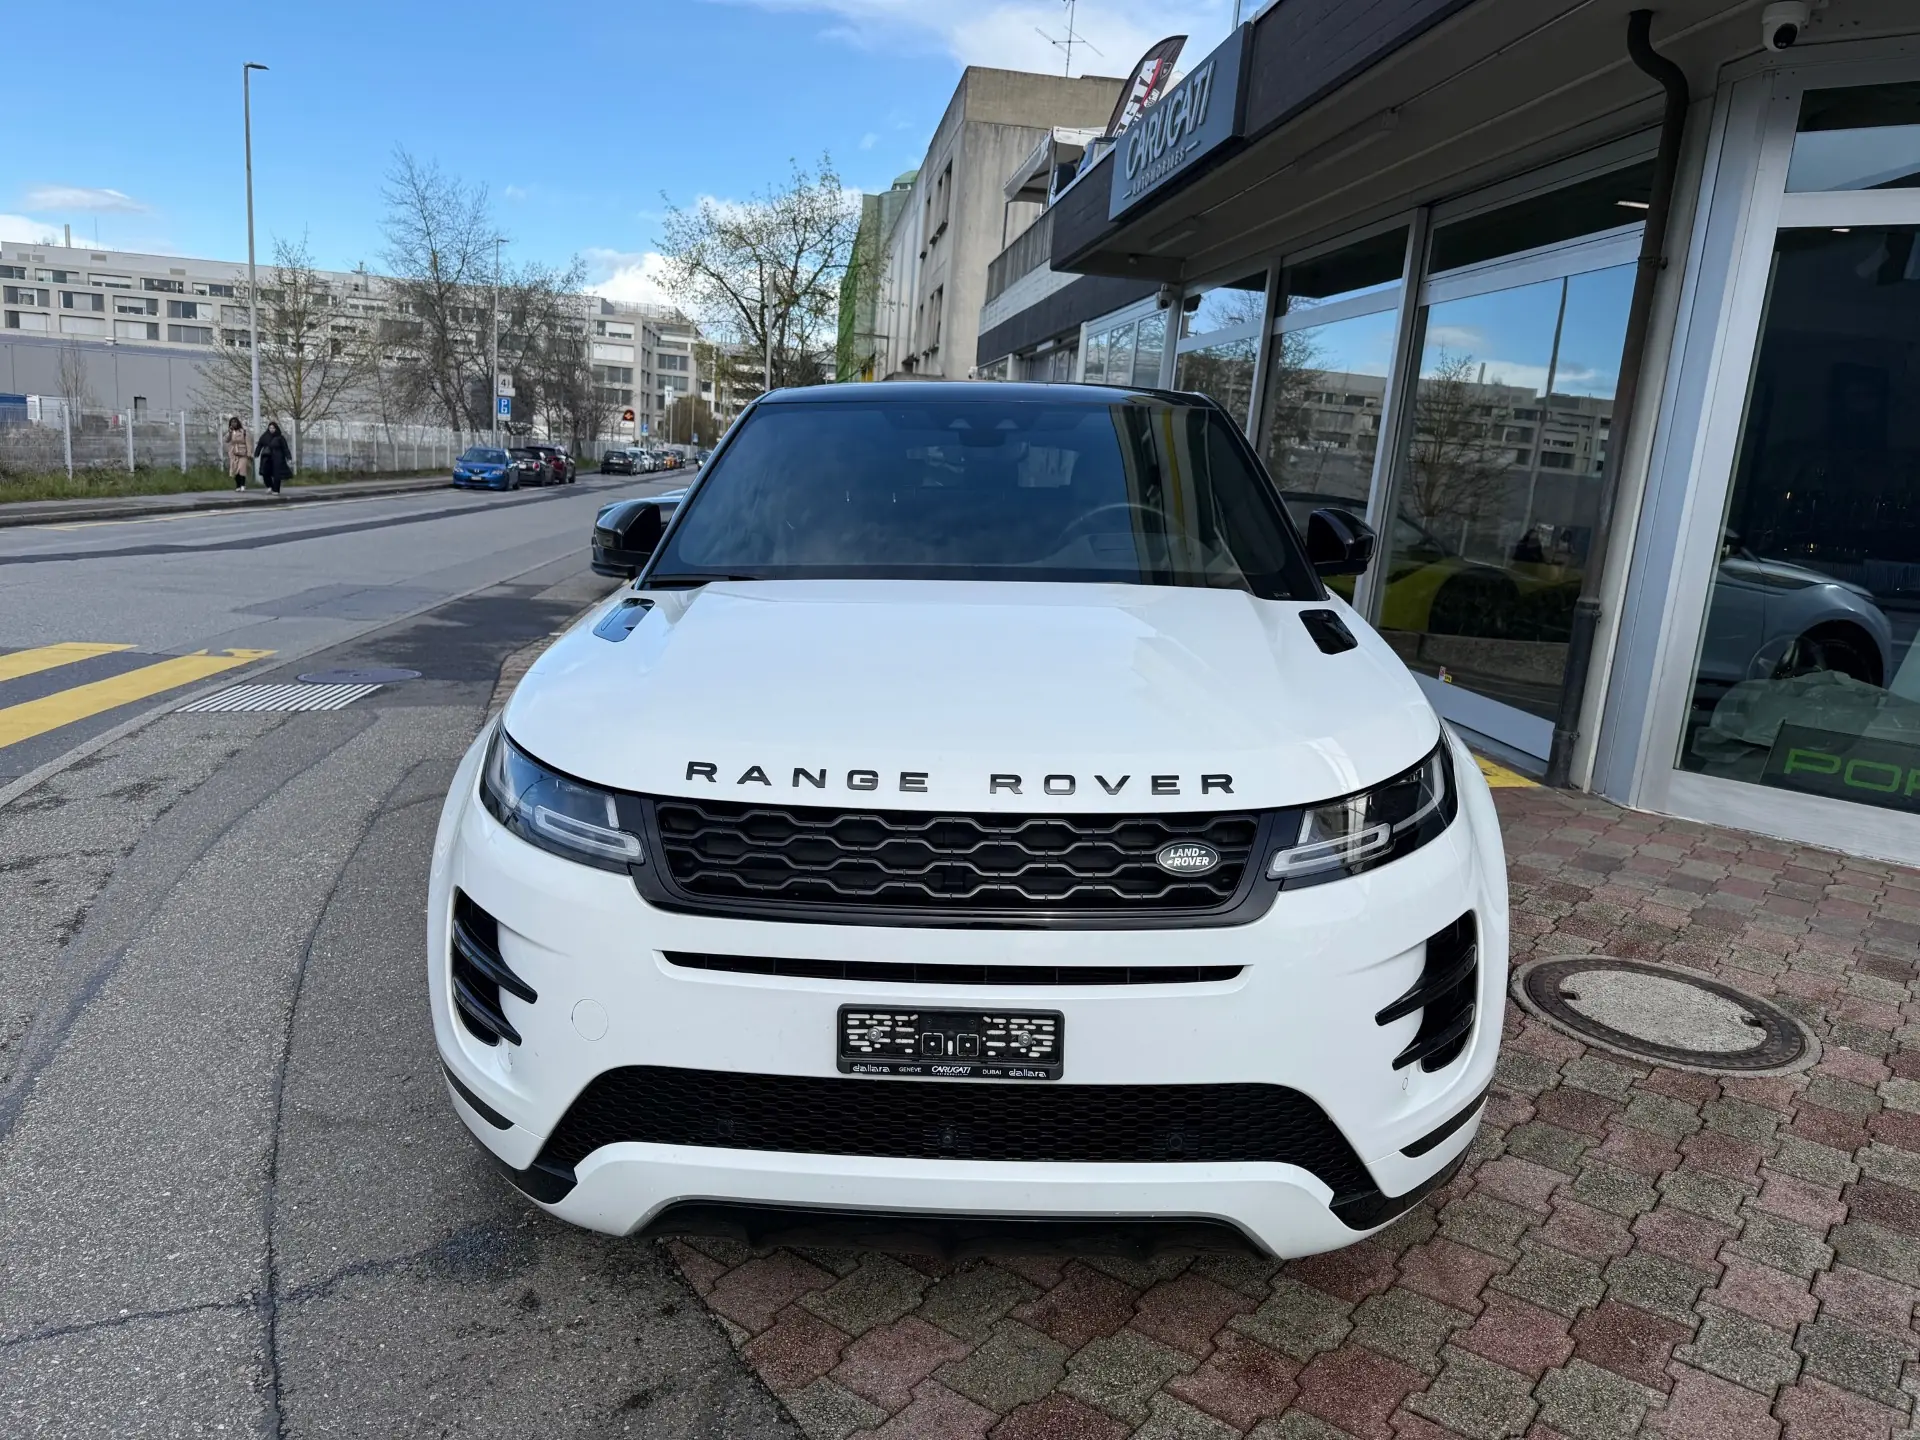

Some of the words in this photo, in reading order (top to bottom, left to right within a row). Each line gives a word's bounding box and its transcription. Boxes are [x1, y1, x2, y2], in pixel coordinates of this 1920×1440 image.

[1126, 60, 1216, 181] CARUGATI
[1132, 146, 1187, 195] AUTOMOBILES
[685, 760, 929, 793] RANGE
[989, 773, 1235, 796] ROVER
[1783, 748, 1920, 797] PO
[1169, 847, 1200, 858] LAND
[1173, 856, 1210, 867] ROVER
[852, 1063, 891, 1073] dallara
[931, 1065, 972, 1074] CARUGATI
[1008, 1068, 1047, 1078] dallara
